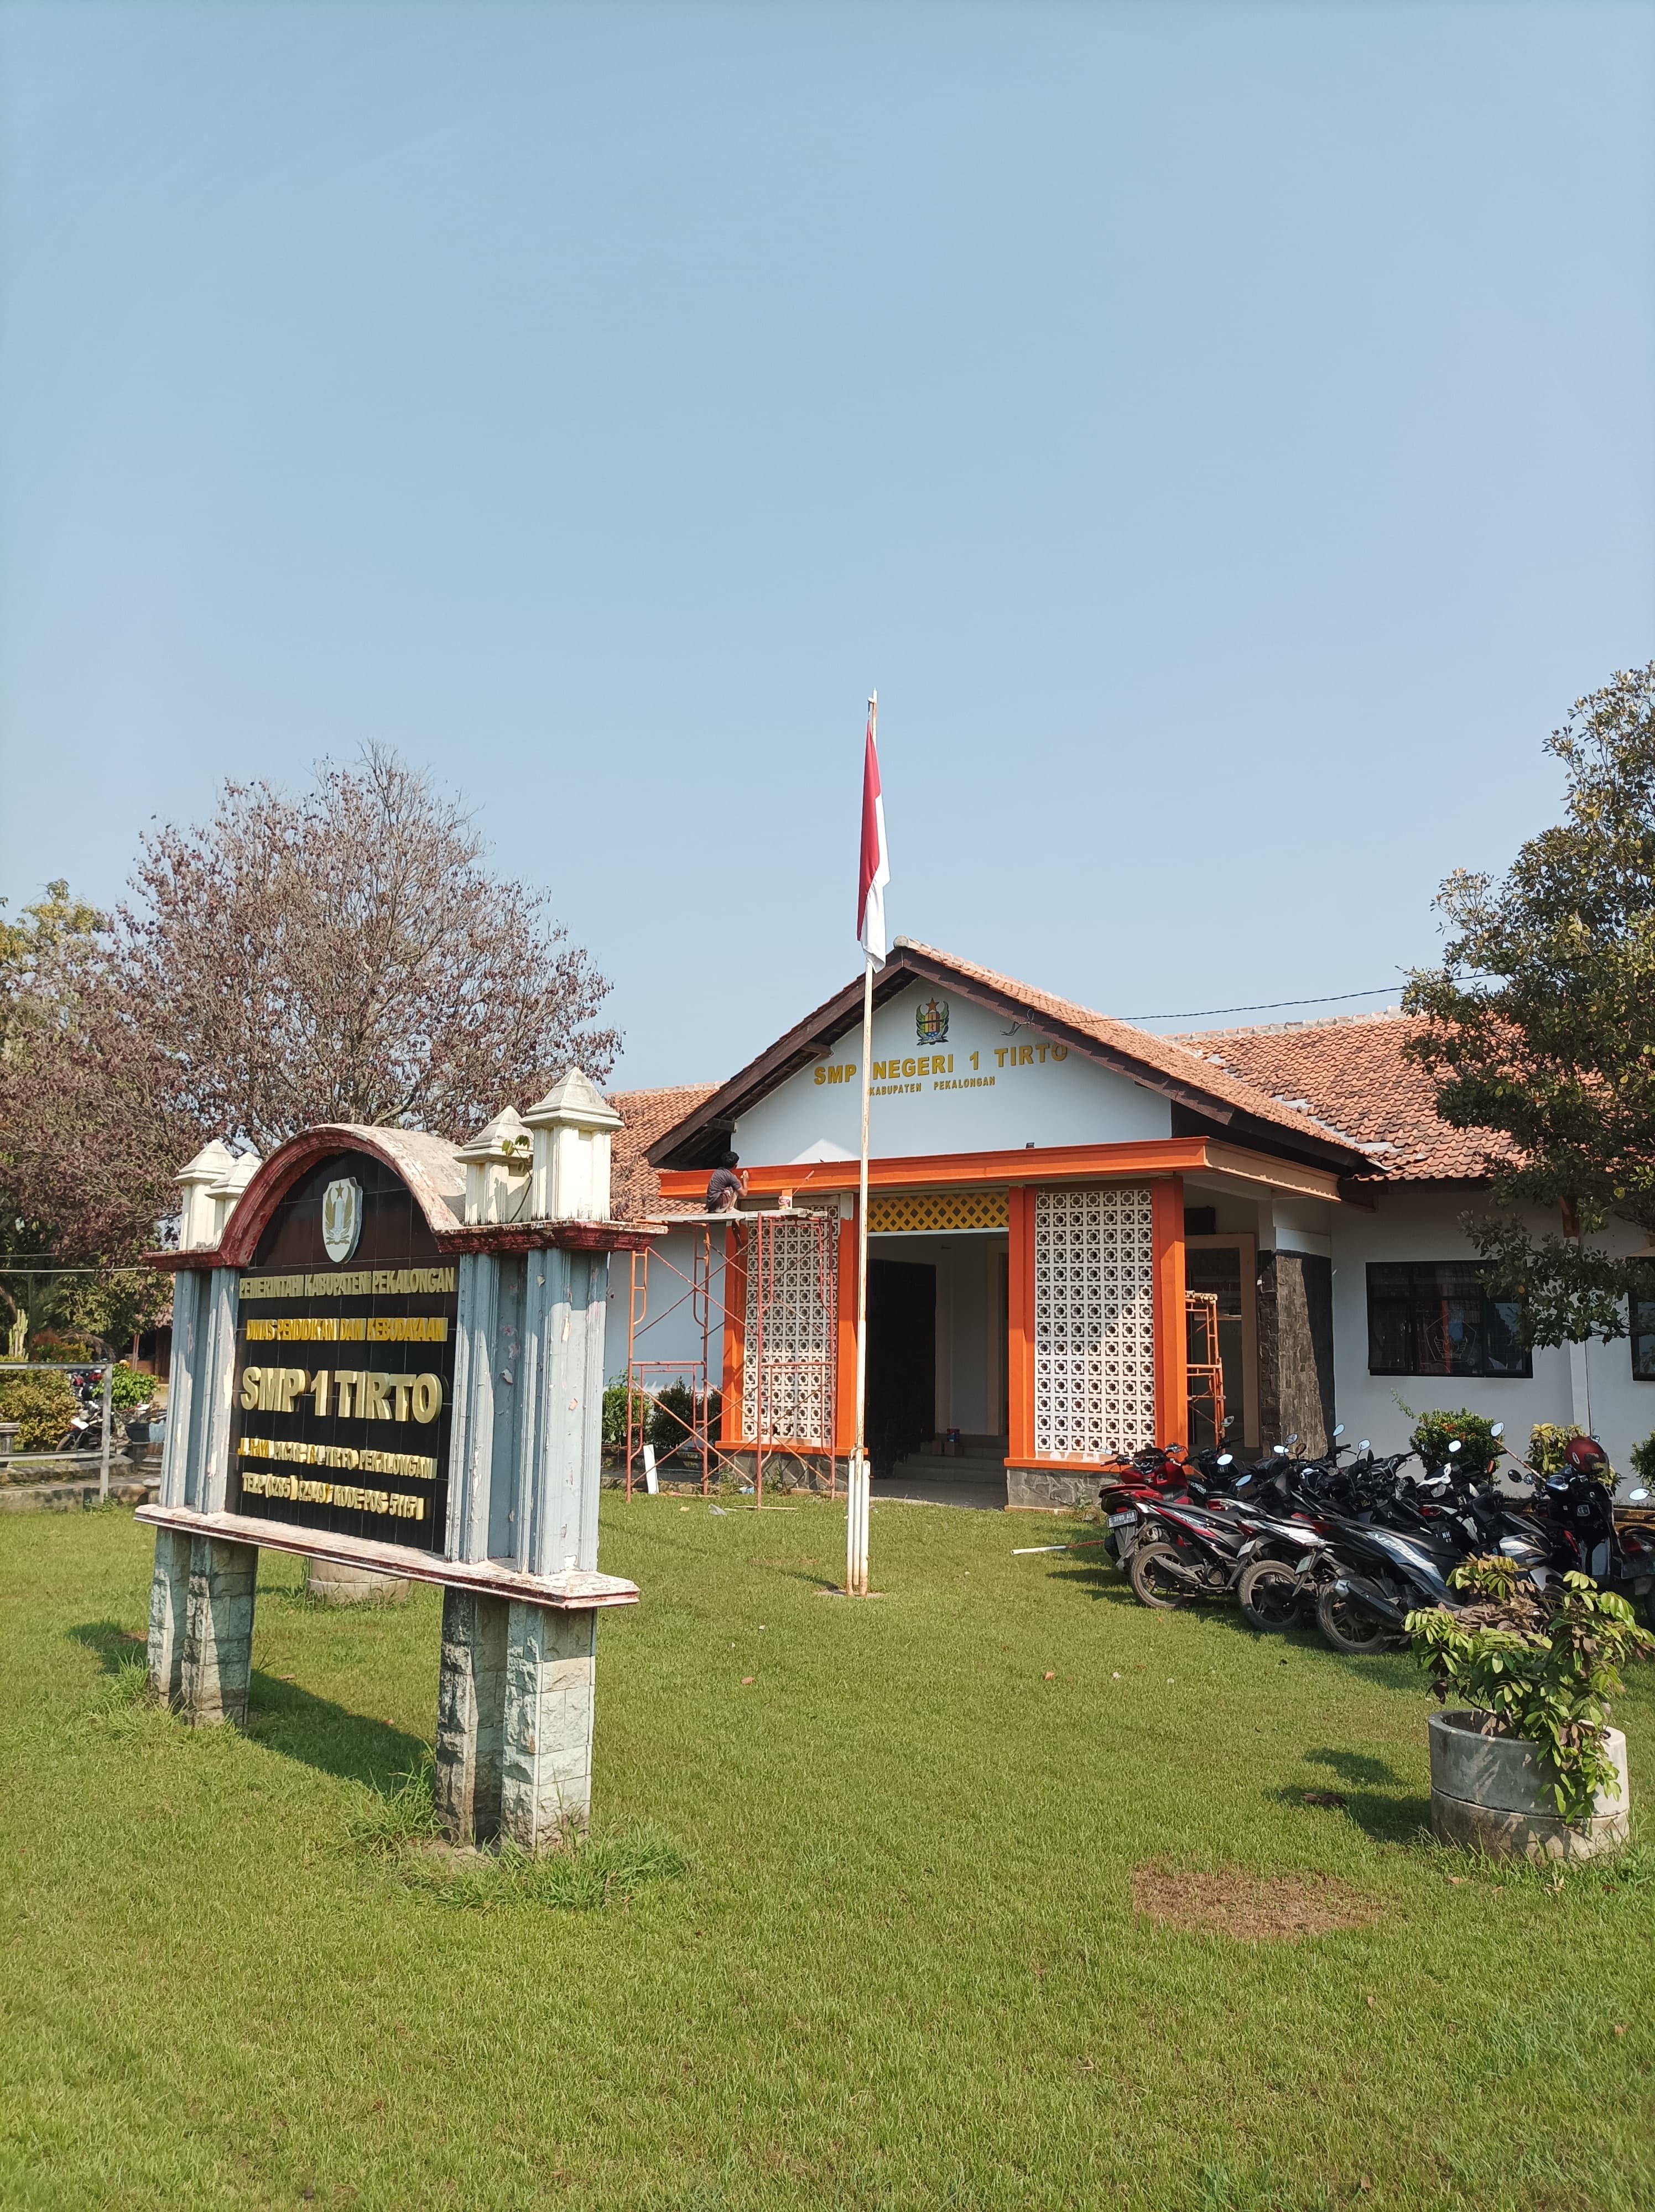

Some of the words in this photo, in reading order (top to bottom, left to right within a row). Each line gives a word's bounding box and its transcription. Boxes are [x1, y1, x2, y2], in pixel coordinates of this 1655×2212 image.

[814, 1065, 857, 1085] SMP
[873, 1054, 954, 1080] NEGERI
[969, 1051, 979, 1071] 1
[994, 1043, 1068, 1068] TIRTO
[870, 1082, 922, 1097] KABUPATEN
[934, 1076, 996, 1091] PEKALONGAN
[239, 1275, 304, 1298] PEMERINTAH
[305, 1272, 372, 1296] KABUPATEN
[372, 1267, 455, 1294] PEKALONGAN
[246, 1319, 277, 1340] DINAS
[277, 1318, 340, 1340] PENDIDIKAN
[340, 1318, 366, 1340] DAN
[367, 1317, 448, 1342] KEBUDAYAAN
[241, 1366, 305, 1412] SMP
[310, 1370, 329, 1416] 1
[335, 1370, 443, 1423] TIRTO
[325, 1446, 359, 1470] TIRTO
[358, 1450, 438, 1479] PEKALONGAN
[334, 1485, 365, 1509] KODE
[363, 1489, 389, 1514] POS
[389, 1493, 424, 1520] 51151
